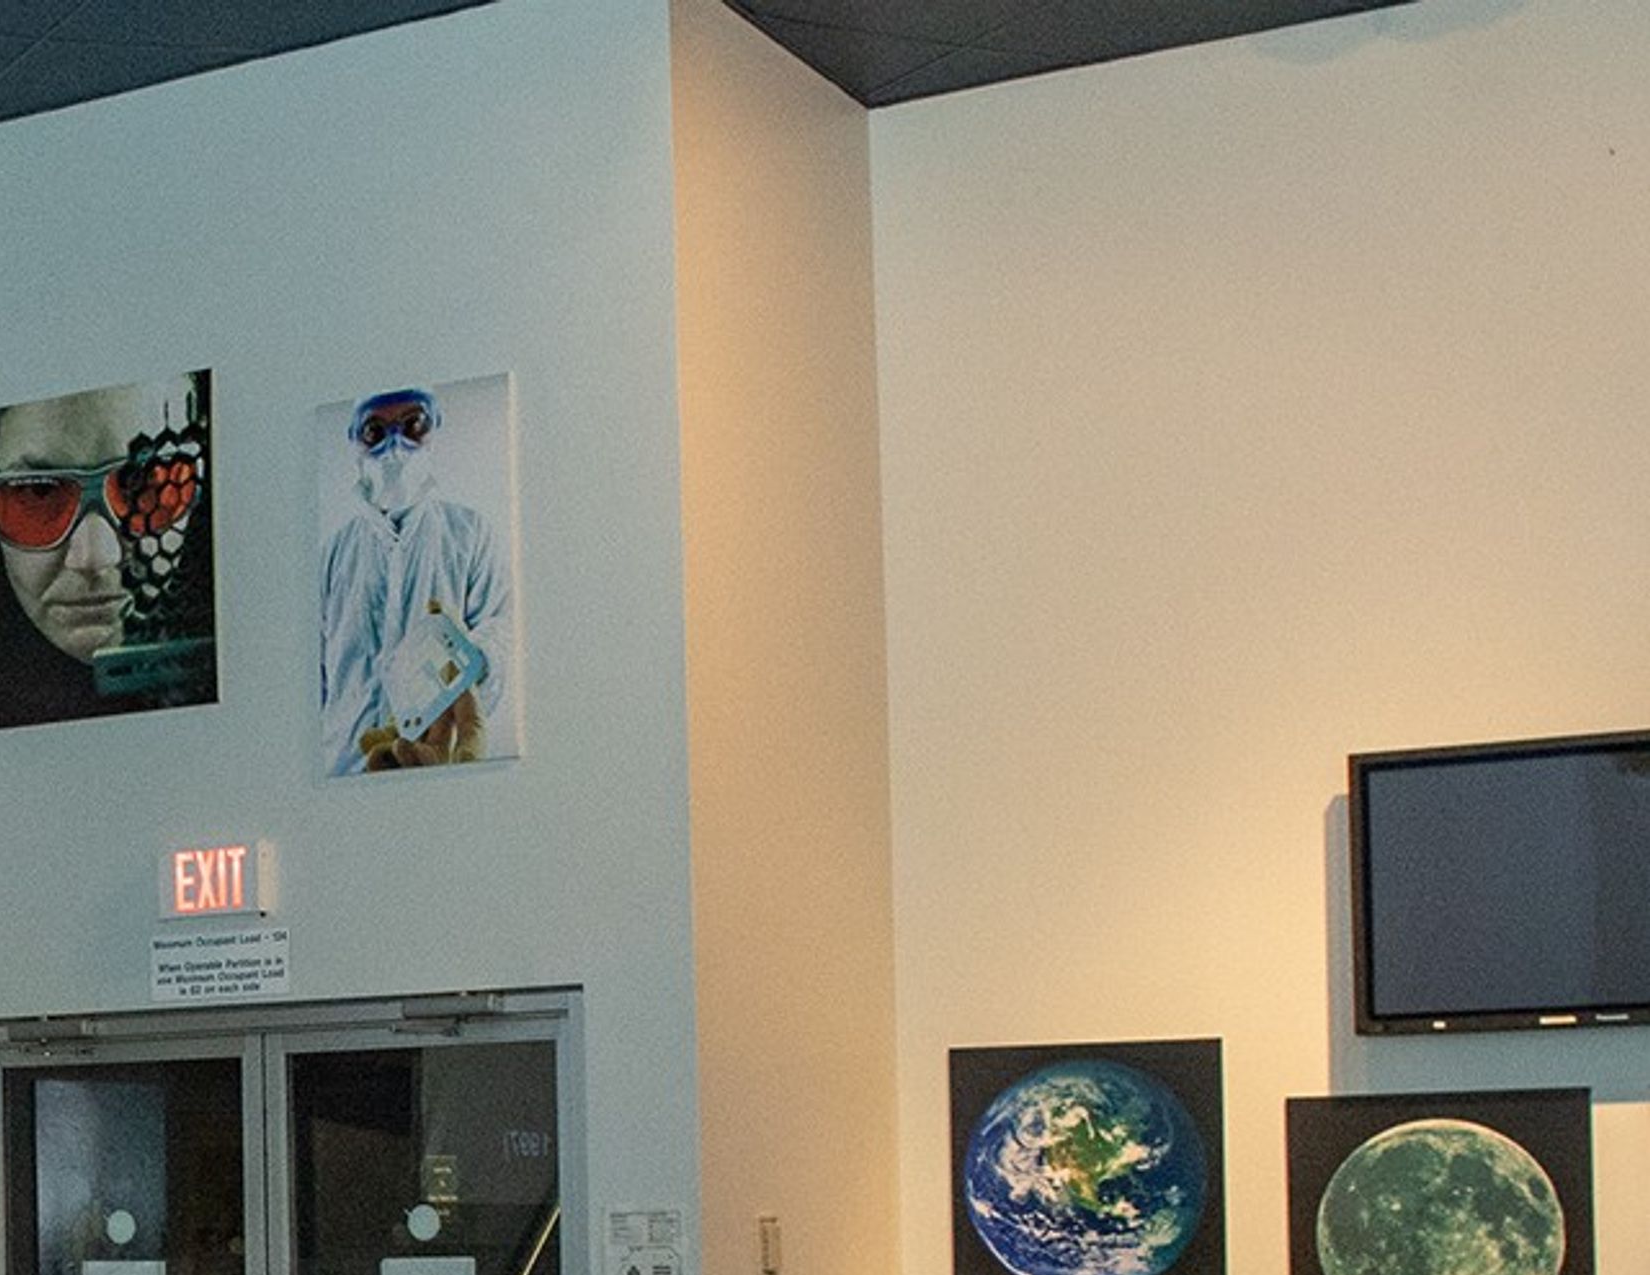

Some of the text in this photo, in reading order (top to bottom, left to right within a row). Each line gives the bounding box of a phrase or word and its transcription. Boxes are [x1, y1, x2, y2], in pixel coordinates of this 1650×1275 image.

[174, 846, 247, 913] EXIT
[153, 939, 192, 950] Maximum
[196, 935, 236, 948] Occupant
[240, 933, 261, 945] Load
[158, 963, 182, 973] When
[183, 960, 223, 972] Operable
[225, 958, 261, 969] Partition
[176, 973, 215, 984] Maximum
[217, 971, 259, 983] Occupant
[261, 968, 285, 980] Load
[218, 982, 239, 993] each
[242, 981, 260, 992] side
